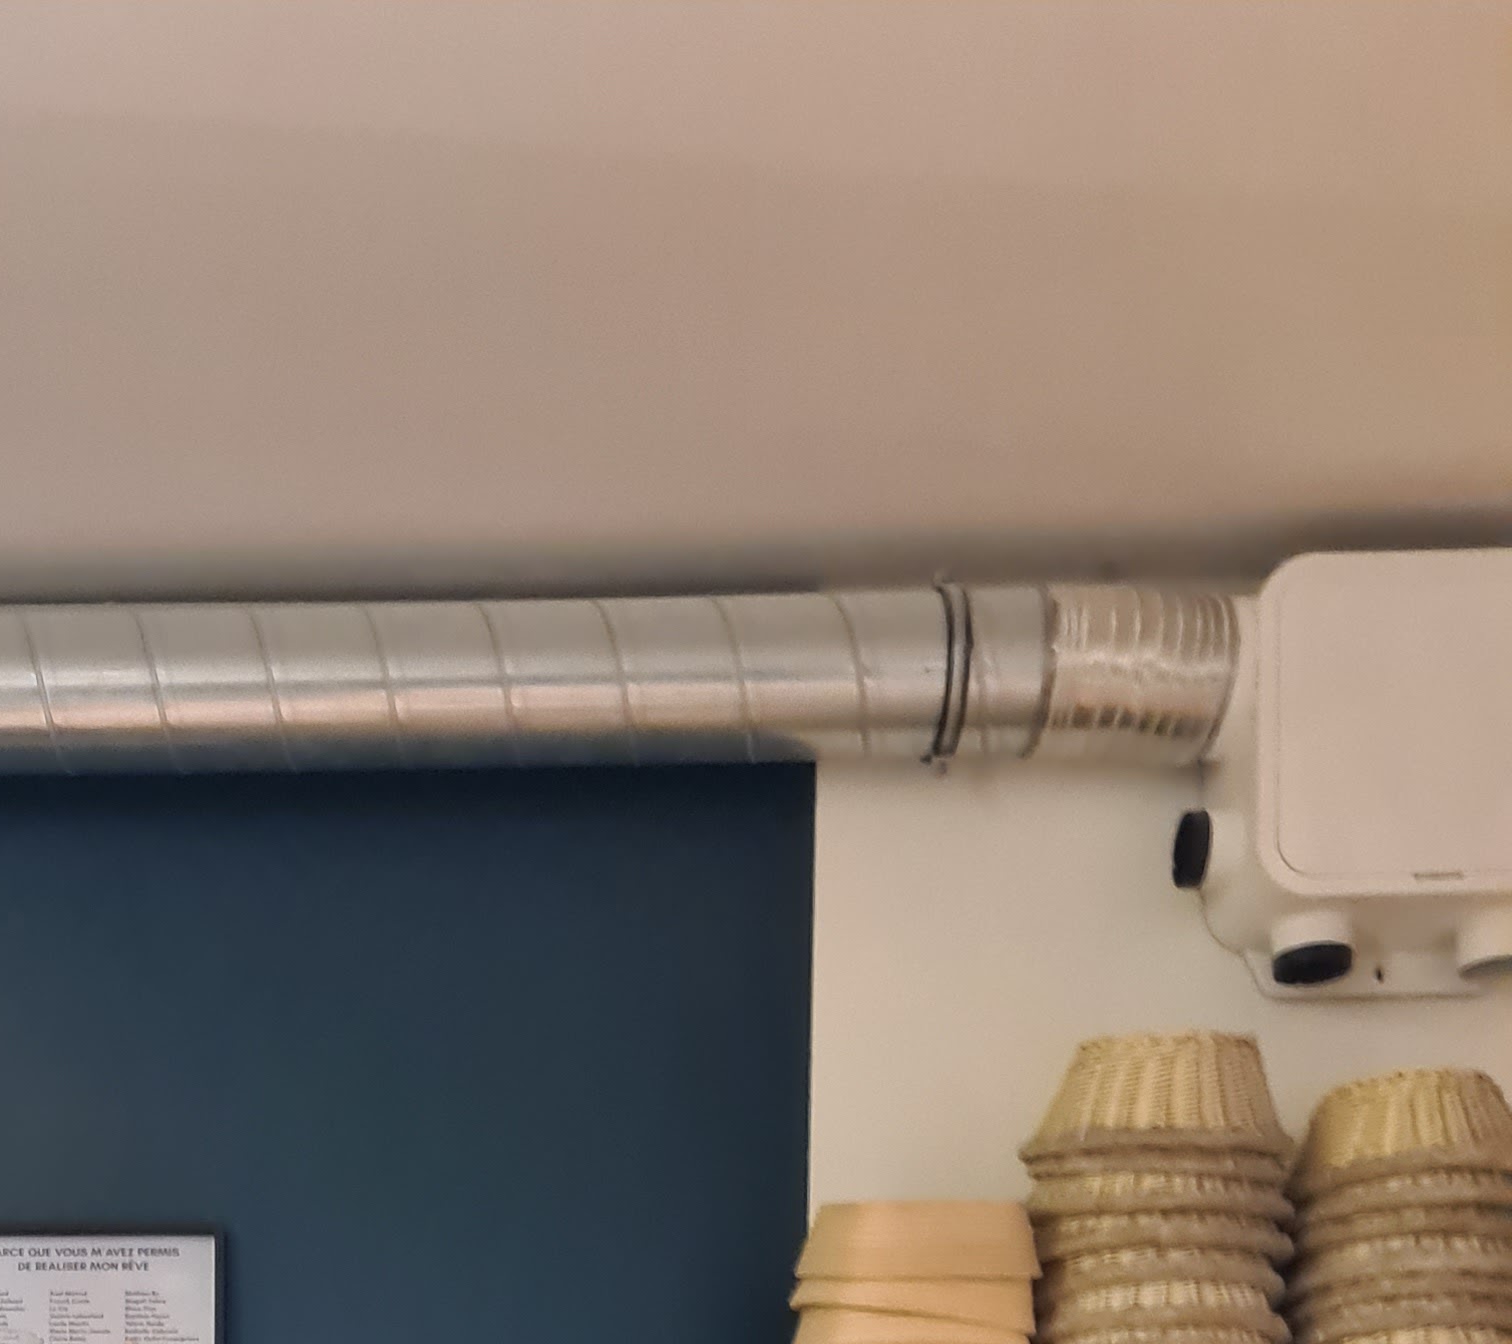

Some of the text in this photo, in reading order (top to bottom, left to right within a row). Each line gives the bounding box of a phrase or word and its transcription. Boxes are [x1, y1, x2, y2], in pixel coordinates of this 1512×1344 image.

[28, 1247, 52, 1258] QUE
[55, 1247, 88, 1258] VOUS
[137, 1247, 180, 1258] PERMIS
[17, 1262, 31, 1272] DE
[90, 1262, 119, 1272] MON
[121, 1260, 149, 1272] RÊVE
